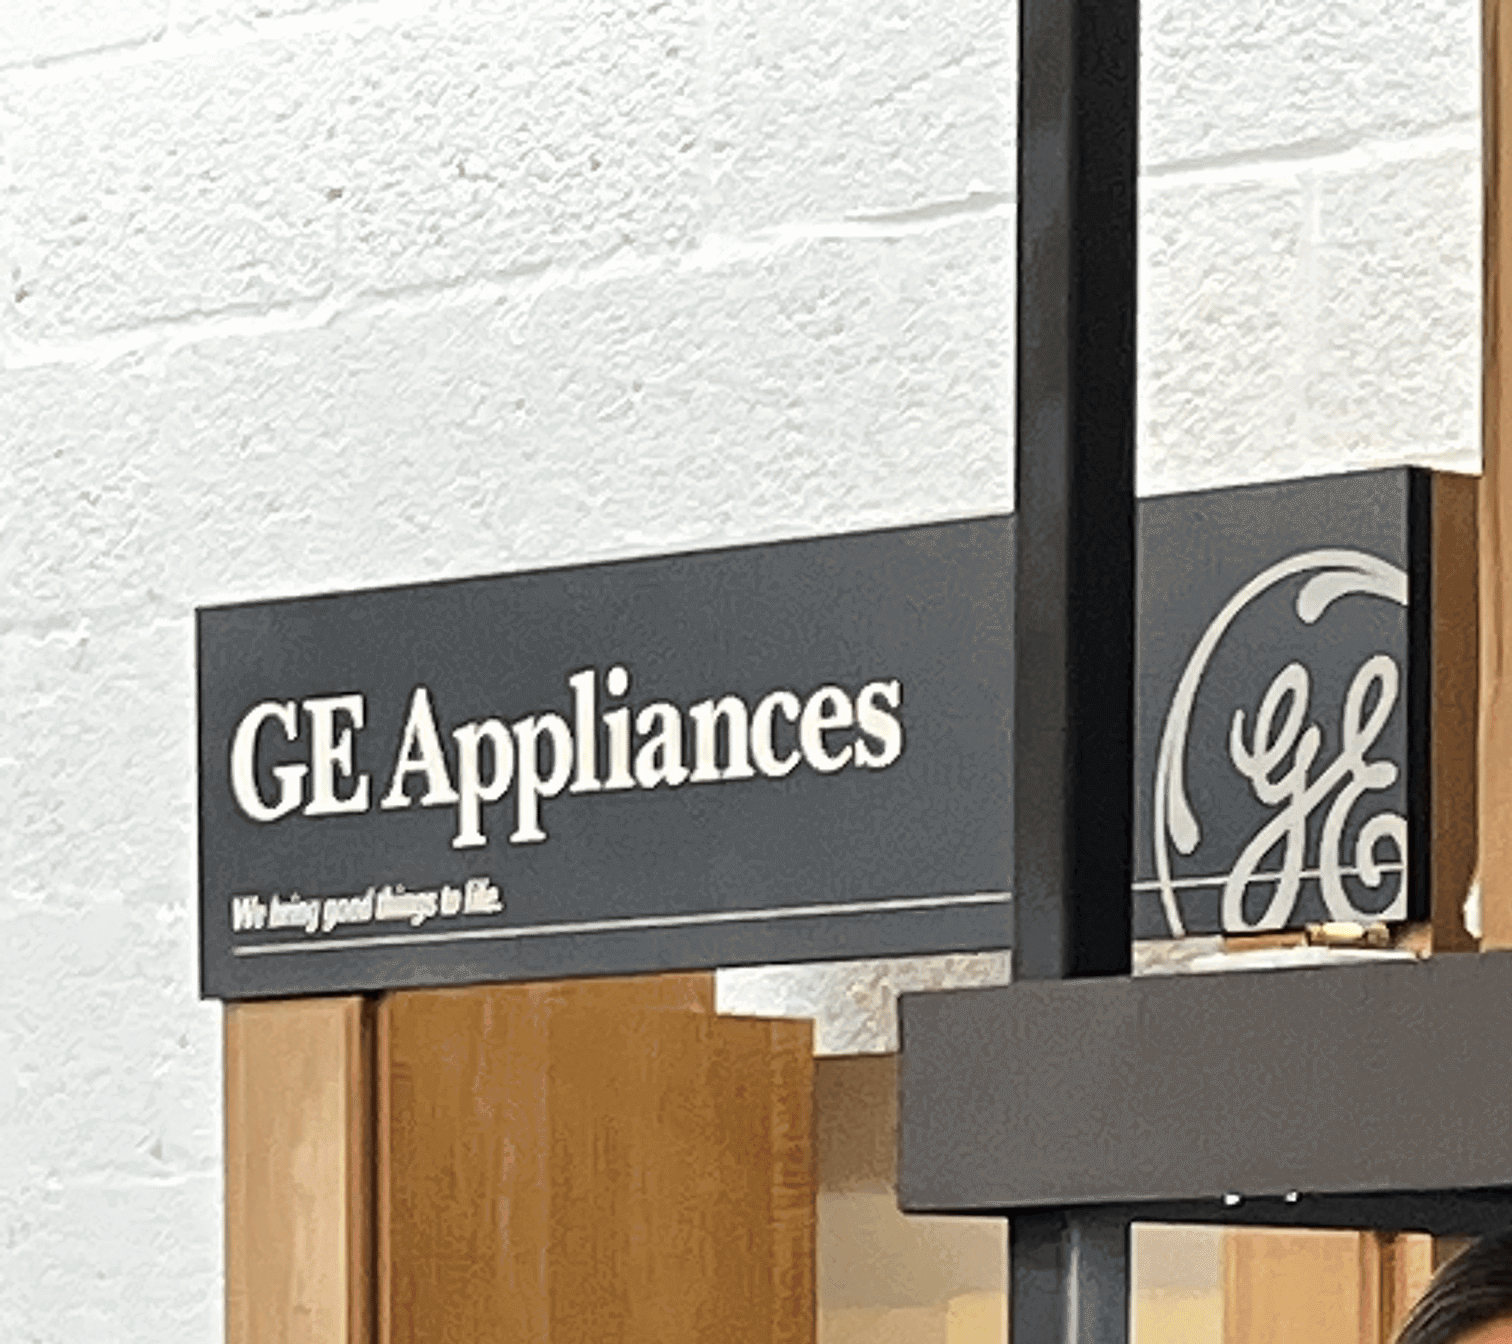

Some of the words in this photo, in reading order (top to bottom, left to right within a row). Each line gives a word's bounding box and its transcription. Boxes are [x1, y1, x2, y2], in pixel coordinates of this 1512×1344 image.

[229, 694, 368, 822] GE
[381, 665, 902, 849] Appliances
[322, 887, 374, 933] good
[440, 885, 462, 916] to
